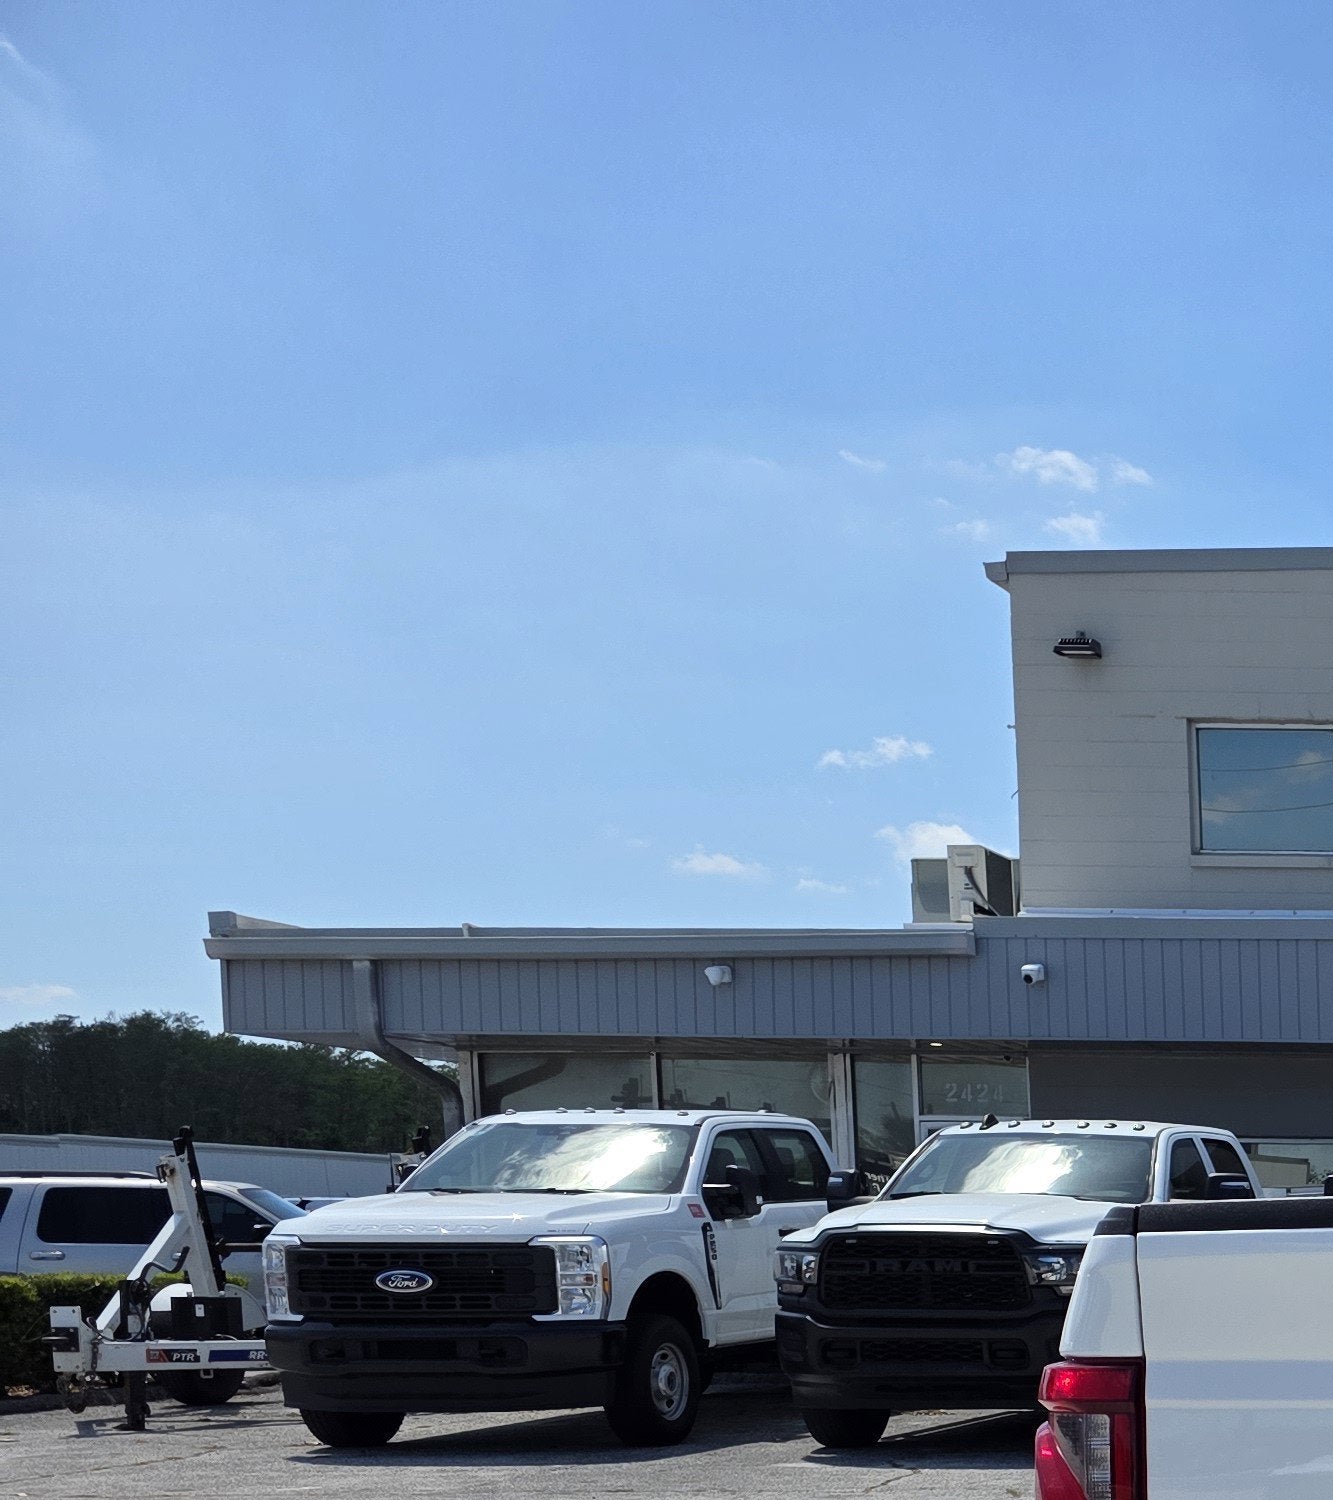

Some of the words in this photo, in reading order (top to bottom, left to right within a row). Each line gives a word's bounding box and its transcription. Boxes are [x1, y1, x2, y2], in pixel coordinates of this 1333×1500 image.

[326, 1224, 416, 1233] SUPER
[421, 1224, 498, 1233] DUTY
[388, 1274, 418, 1289] Ford
[172, 1353, 195, 1362] PTR
